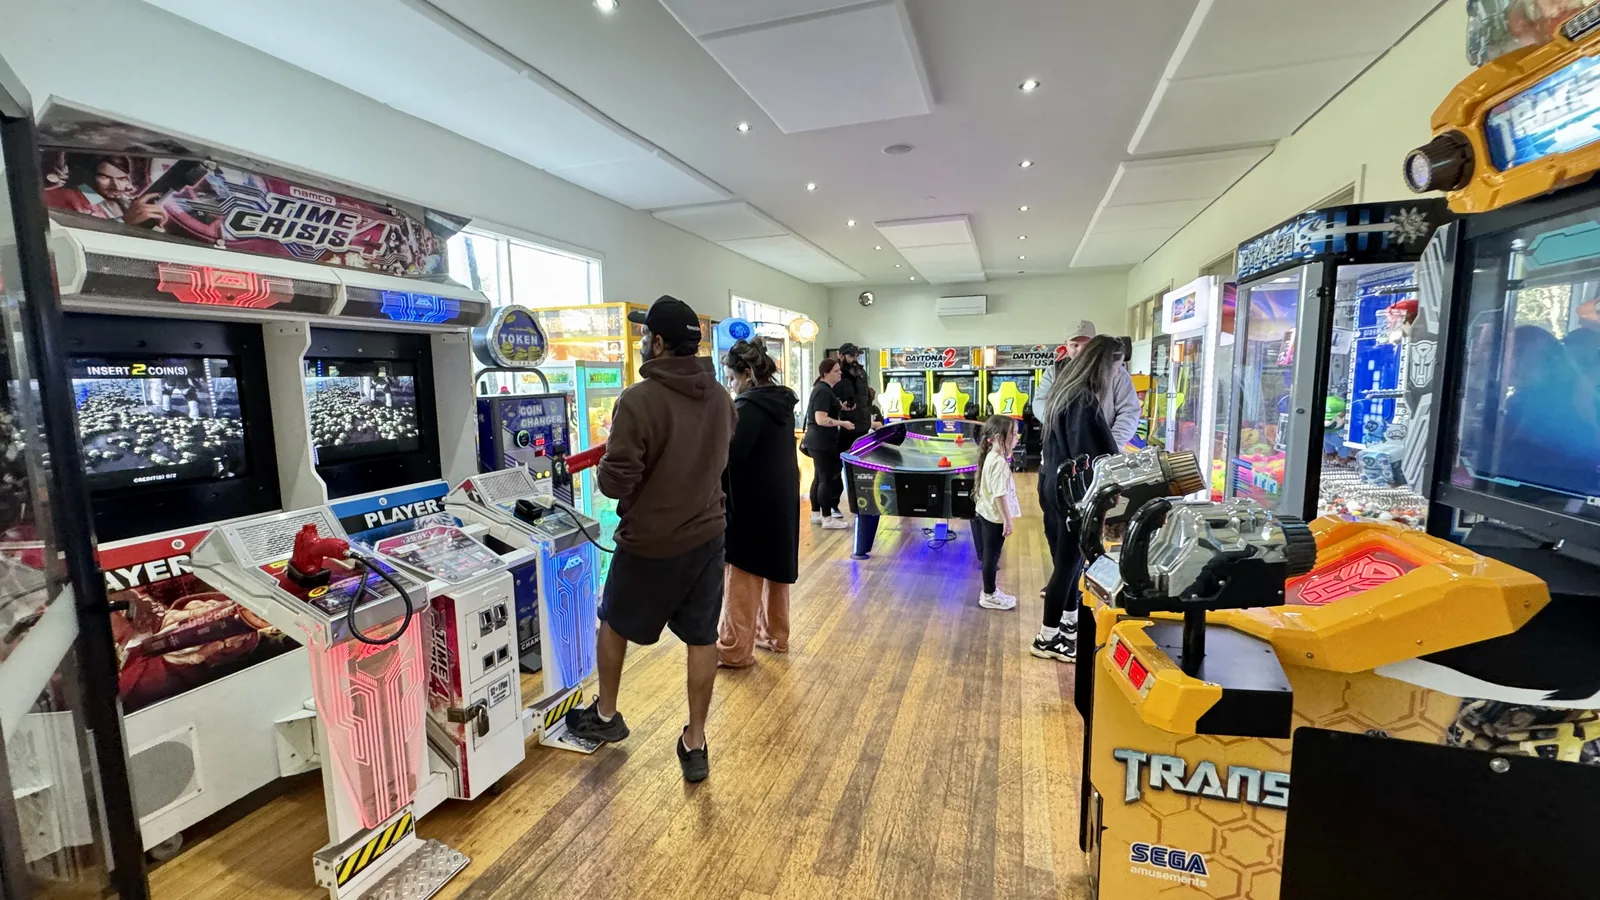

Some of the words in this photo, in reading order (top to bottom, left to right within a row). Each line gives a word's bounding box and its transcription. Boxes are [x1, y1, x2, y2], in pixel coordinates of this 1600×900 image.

[292, 188, 333, 204] namco
[270, 196, 358, 230] TIME
[229, 210, 348, 249] CRISIS
[350, 221, 387, 258] 4
[500, 333, 538, 345] TOKEN
[905, 354, 943, 362] DAYTONA
[943, 348, 957, 367] 2
[1013, 352, 1054, 360] DAYTONA
[1055, 345, 1068, 361] 2
[87, 366, 130, 376] INSERT
[131, 363, 147, 375] 2
[148, 366, 188, 376] COIN(S)
[1034, 359, 1054, 367] USA
[520, 405, 542, 416] COIN
[942, 398, 956, 414] 2
[1001, 398, 1014, 414] 1
[521, 415, 562, 428] CHANGER
[364, 498, 440, 529] PLAYER
[521, 635, 541, 651] CHAN
[436, 630, 449, 682] TIME
[1113, 748, 1289, 810] TRANS
[1131, 842, 1208, 877] SEGA
[1130, 866, 1208, 888] amusements
